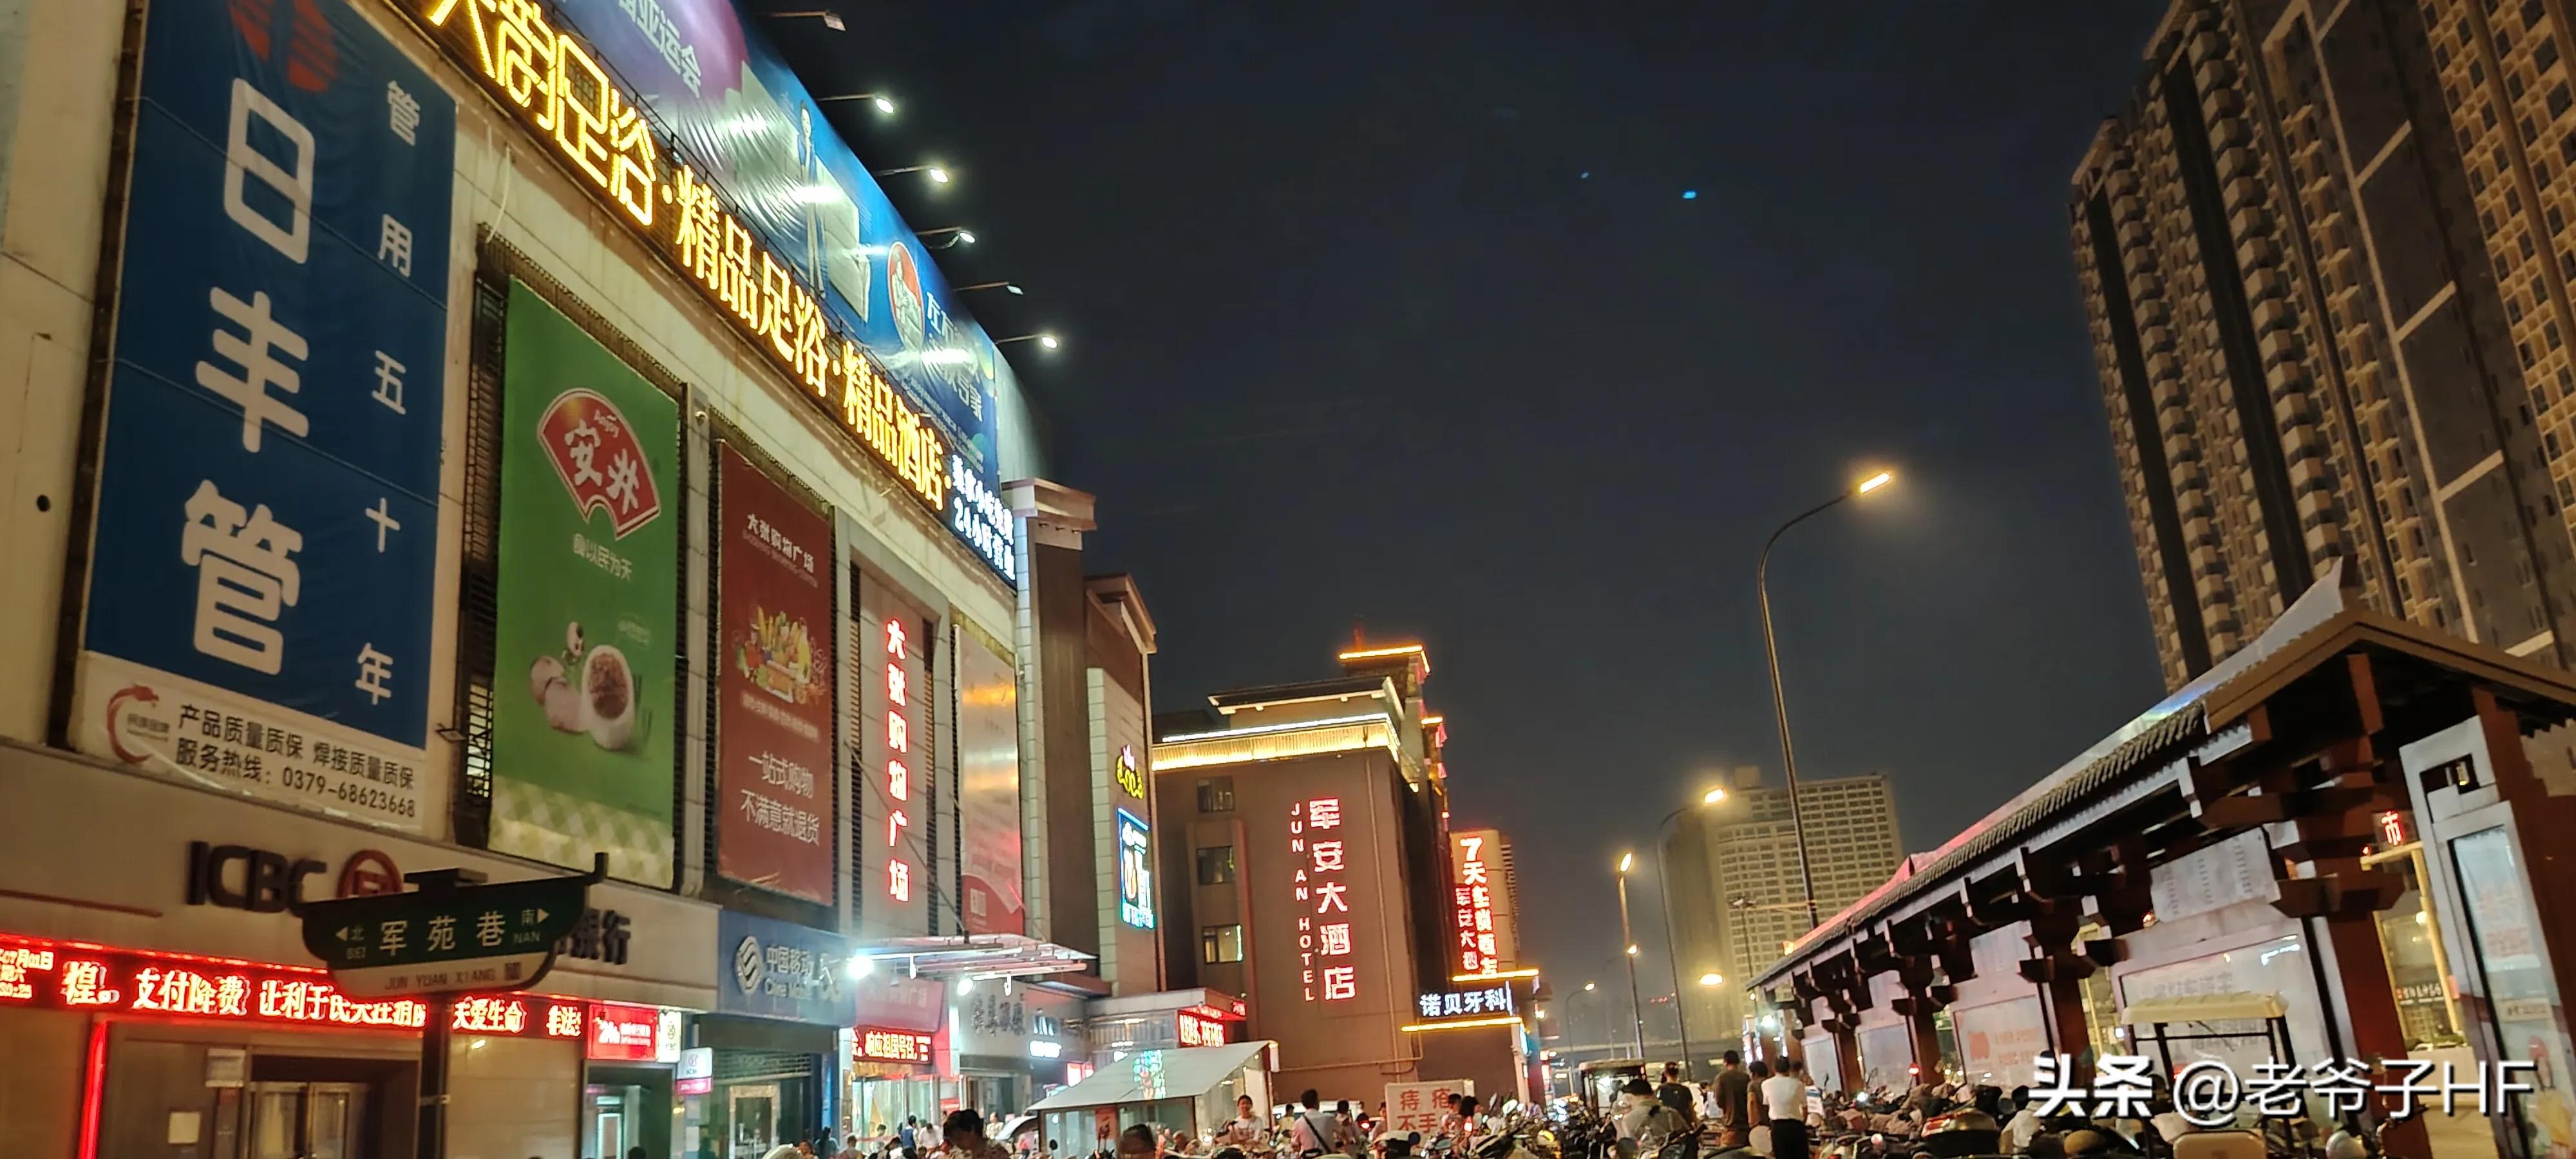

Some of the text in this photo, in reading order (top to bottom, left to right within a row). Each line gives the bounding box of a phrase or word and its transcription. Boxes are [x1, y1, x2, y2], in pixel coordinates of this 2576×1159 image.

[178, 704, 414, 791] 产品质量质保 焊接质量质保
[748, 750, 814, 800] 一站式购物
[885, 618, 910, 901] 大张购物广场
[740, 788, 820, 847] 不满意就退货
[185, 839, 327, 918] ICBC
[1291, 802, 1316, 1002] JUN AN HOTEL
[1309, 798, 1356, 1000] 军安大酒店
[379, 910, 506, 957] 军苑巷
[130, 967, 253, 1016] 支付降费
[1419, 987, 1508, 1017] 诺贝牙科
